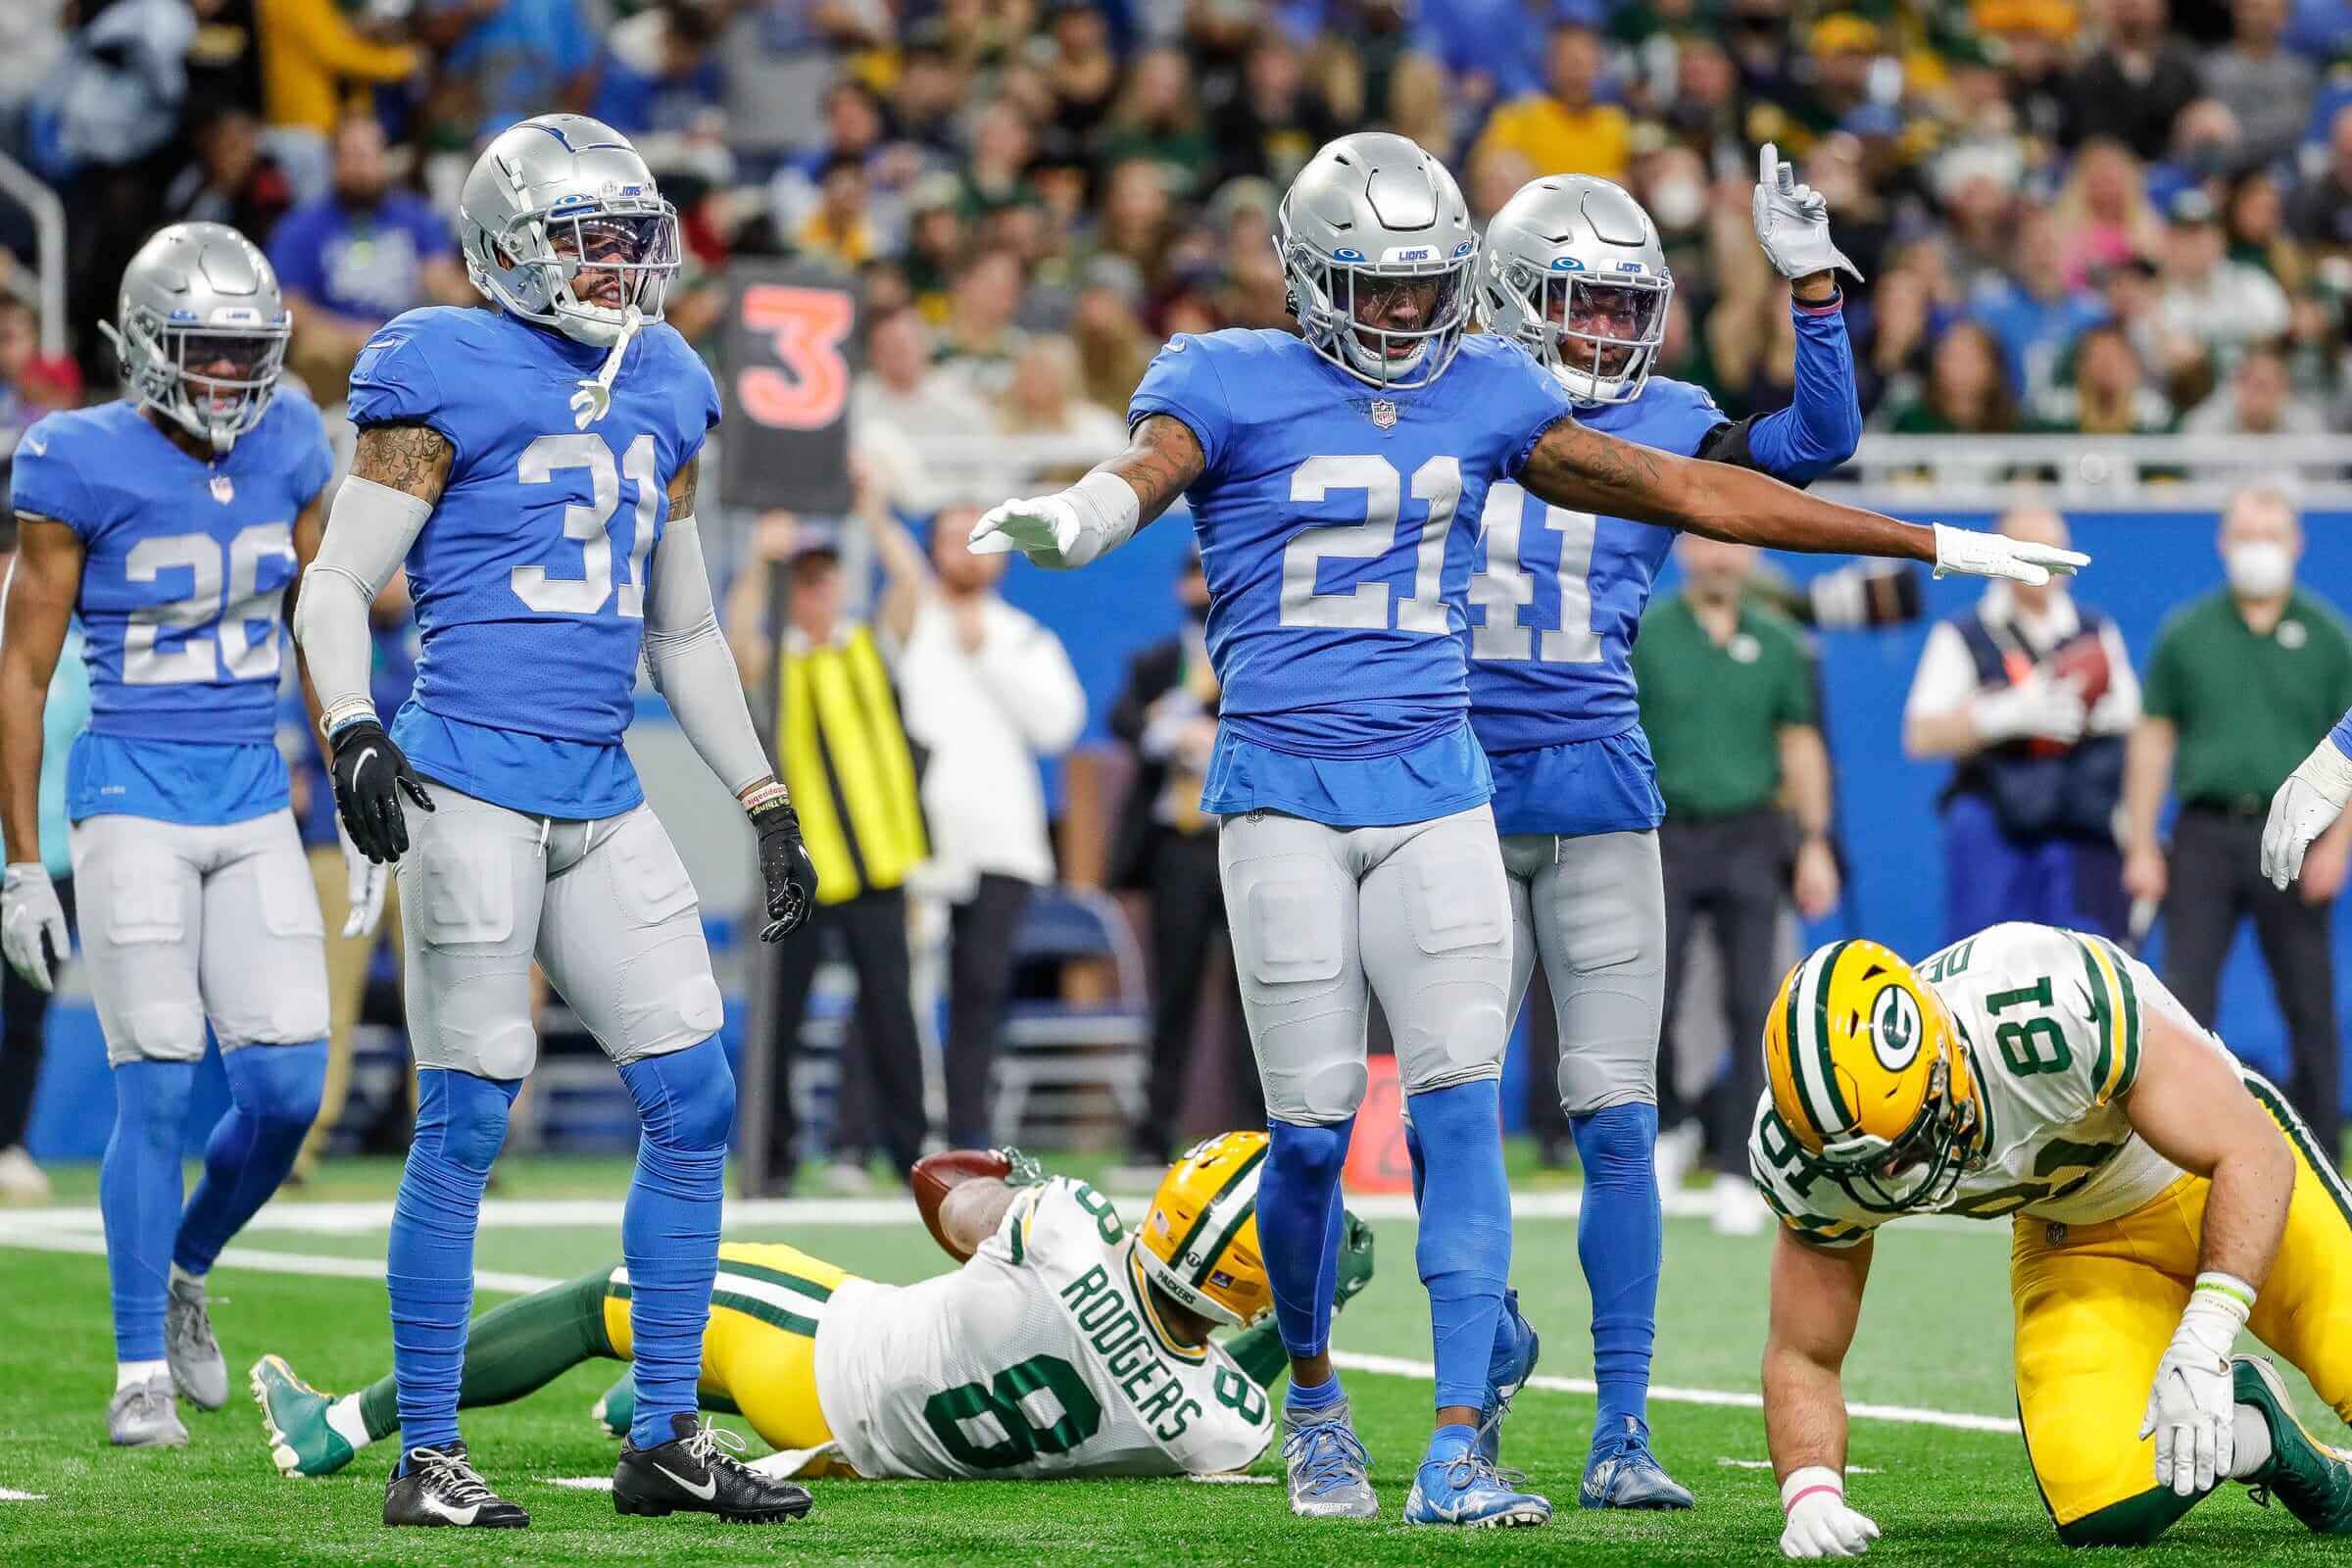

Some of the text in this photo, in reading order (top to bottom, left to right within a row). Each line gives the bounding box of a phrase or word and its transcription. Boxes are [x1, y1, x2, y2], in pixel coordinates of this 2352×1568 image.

[1399, 249, 1429, 261] LIONS
[737, 284, 856, 429] 3
[511, 433, 659, 618] 31
[1280, 455, 1462, 636] 21
[1467, 481, 1604, 663] 41
[1986, 976, 2074, 1077] 81
[1075, 1184, 1124, 1248] 8
[1156, 1270, 1197, 1304] PACKERS
[1060, 1263, 1203, 1442] RODGERS
[1213, 1363, 1265, 1426] 8
[924, 1353, 1103, 1470] 8
